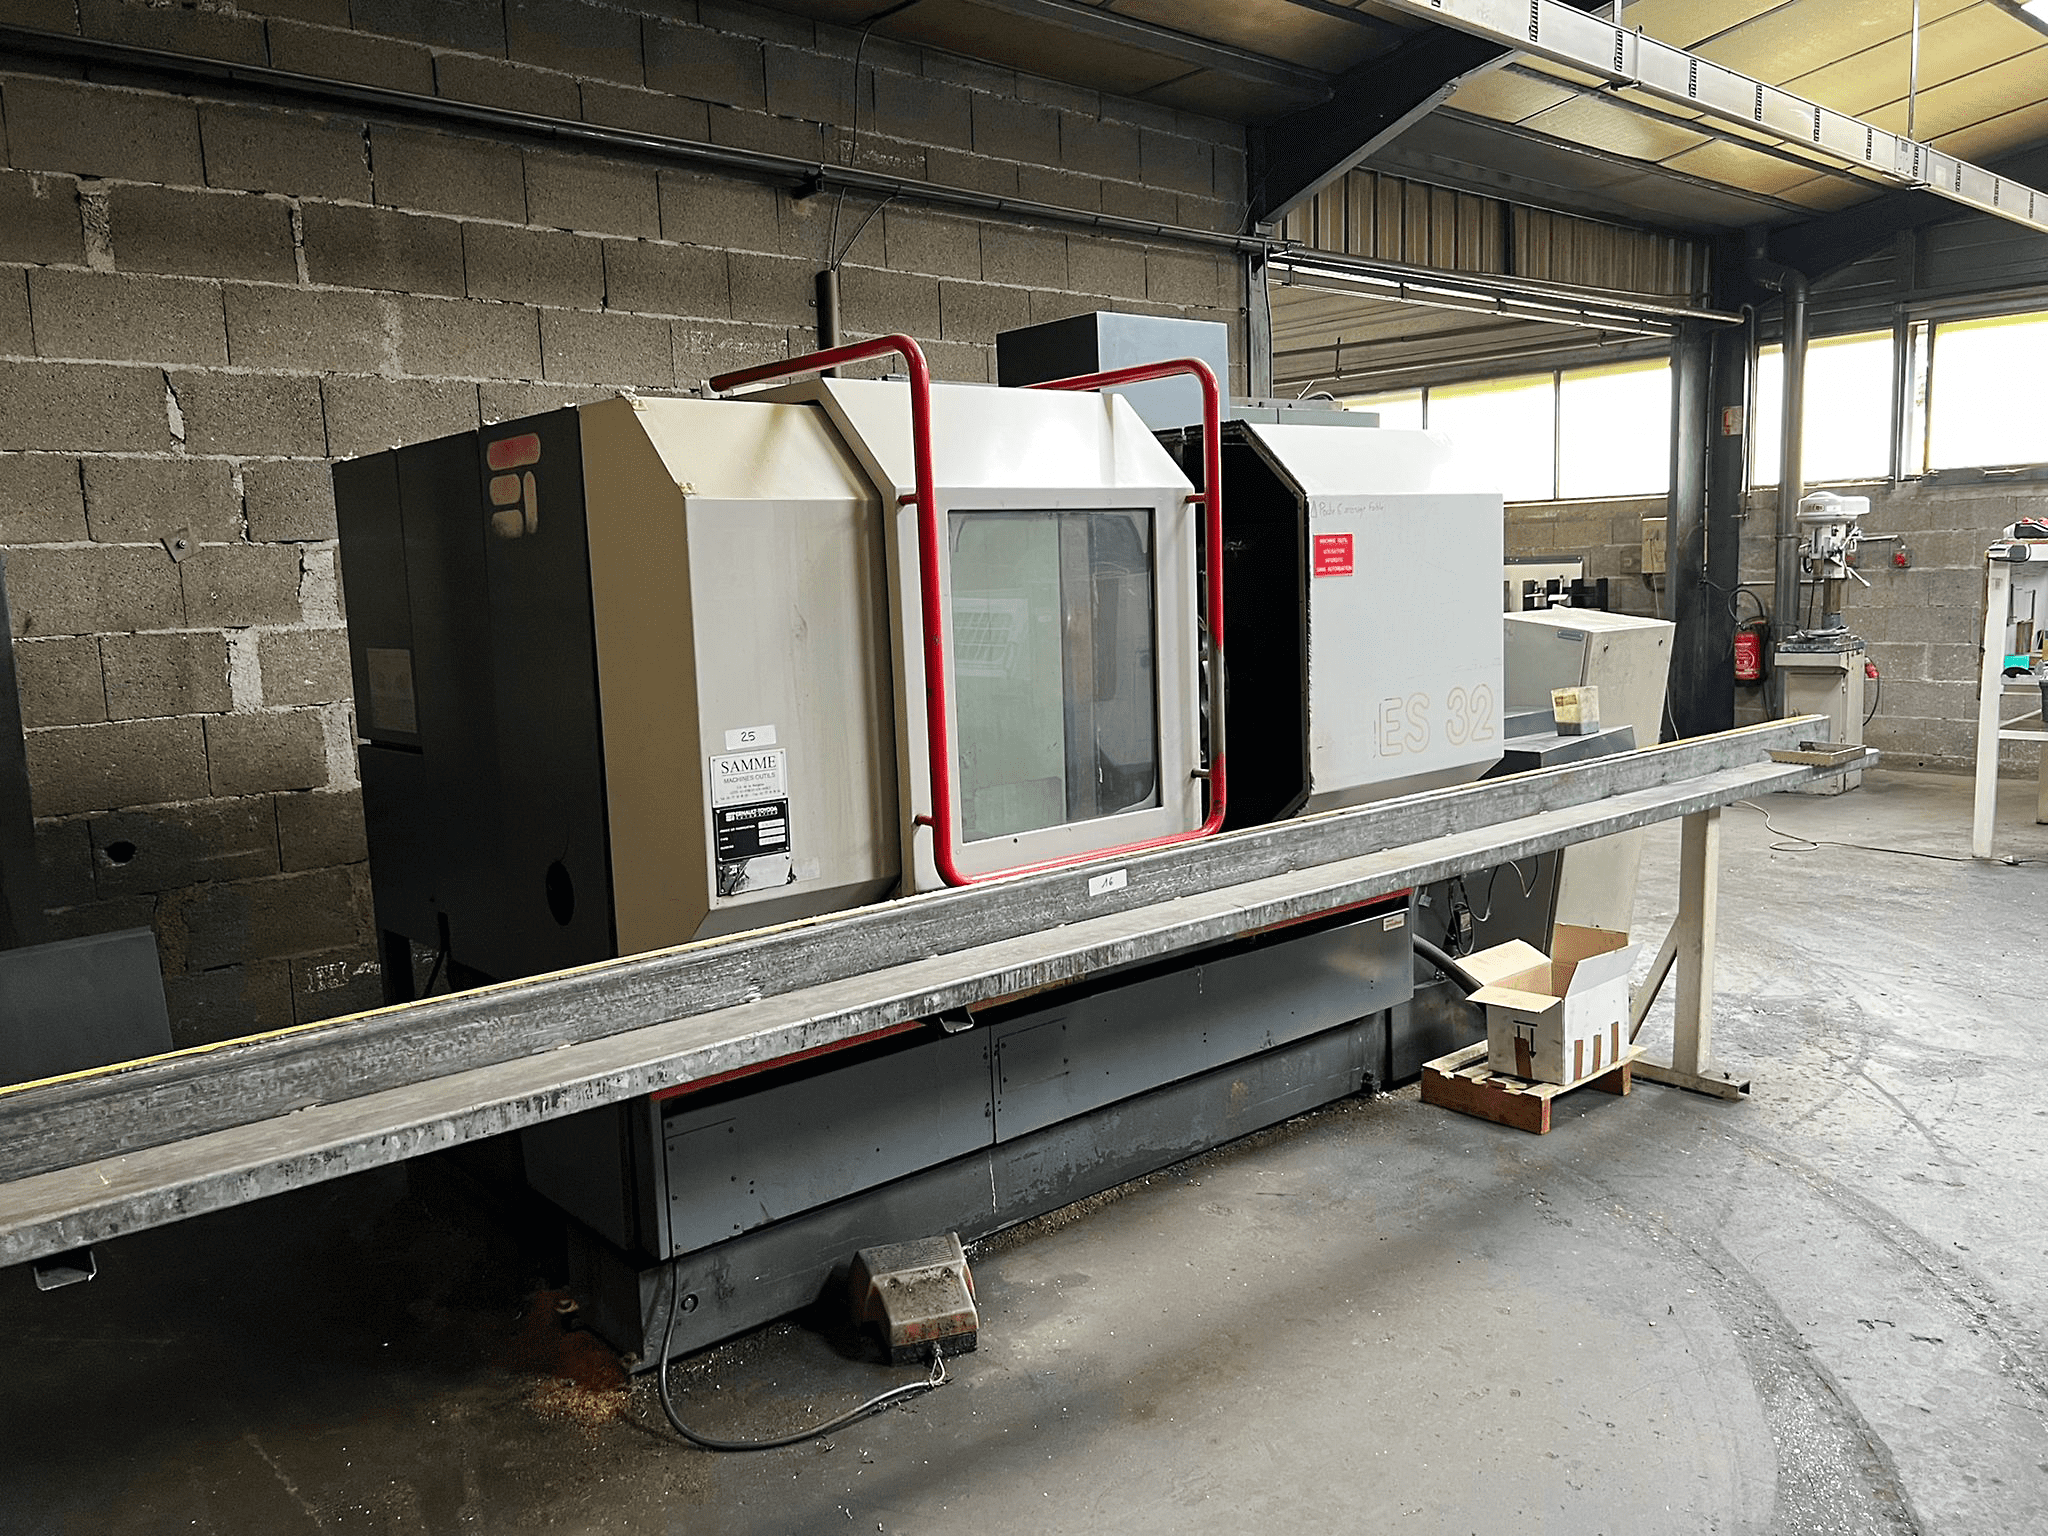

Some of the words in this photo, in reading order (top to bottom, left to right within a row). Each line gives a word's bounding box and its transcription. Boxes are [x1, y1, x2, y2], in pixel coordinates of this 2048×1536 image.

[1378, 691, 1431, 757] ES
[1445, 682, 1494, 746] 32
[740, 730, 756, 742] 25
[720, 755, 777, 774] SAMME
